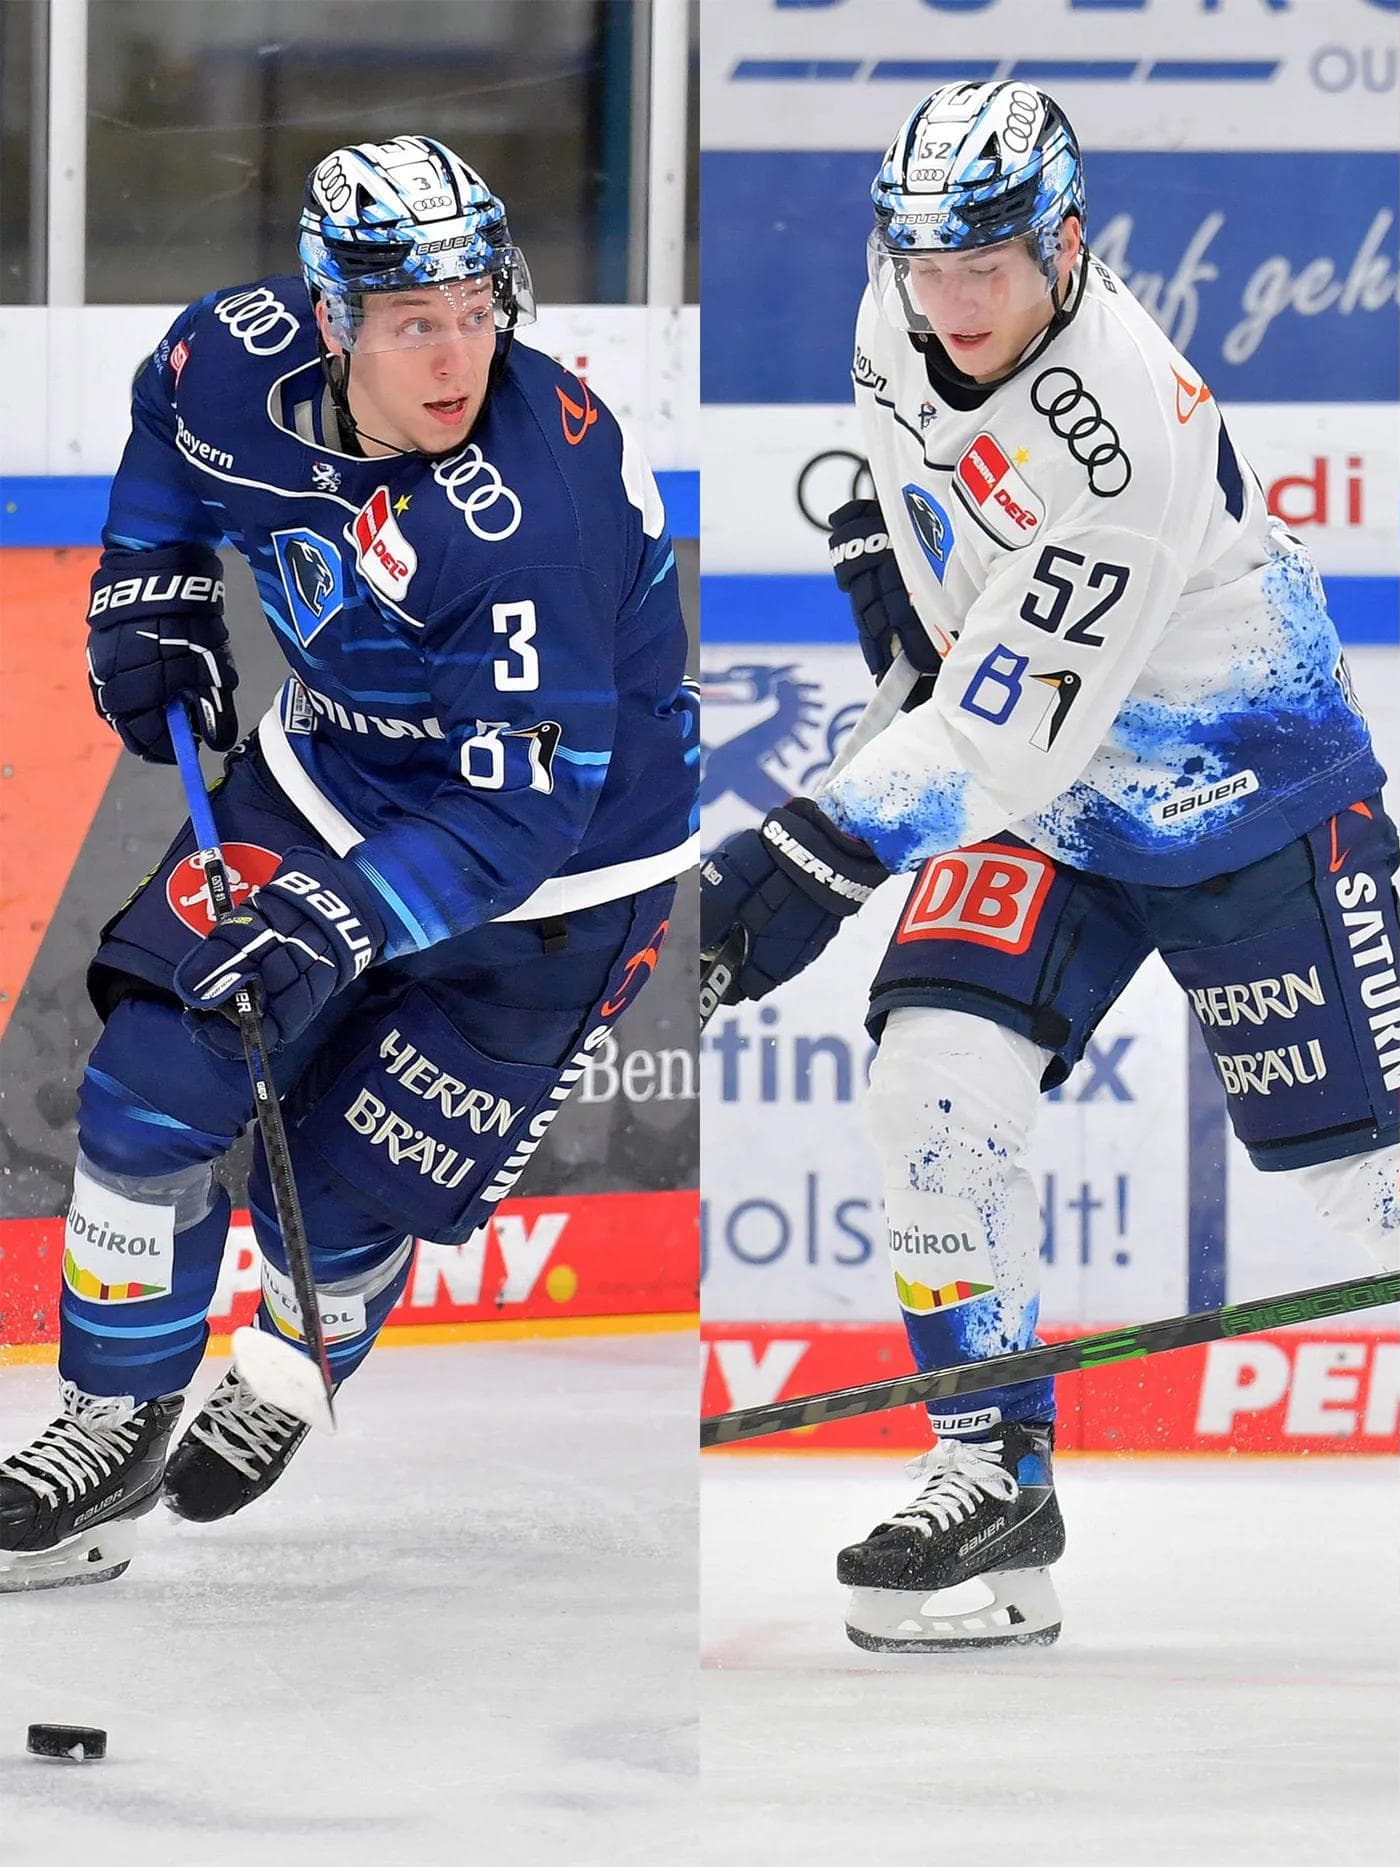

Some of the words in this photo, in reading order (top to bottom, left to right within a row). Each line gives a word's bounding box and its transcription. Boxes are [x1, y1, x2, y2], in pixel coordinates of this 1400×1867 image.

[920, 142, 952, 160] 52
[412, 176, 431, 191] 3
[416, 234, 476, 256] BAUER
[1221, 207, 1400, 366] geh
[993, 488, 1038, 531] DEL
[1267, 456, 1360, 527] di
[829, 532, 894, 567] WOO
[88, 574, 226, 619] BAUER
[1019, 545, 1131, 648] 52
[491, 598, 540, 693] 3
[1161, 776, 1249, 820] BAUER
[912, 858, 1030, 930] DB
[1188, 964, 1326, 1026] HERRN
[379, 1028, 526, 1137] HERRN
[1215, 1038, 1328, 1096] BRÄU
[344, 1087, 476, 1189] BRÄU
[932, 1411, 992, 1430] AUER
[73, 1487, 124, 1527] BAUER
[958, 1515, 1006, 1557] BAUER
